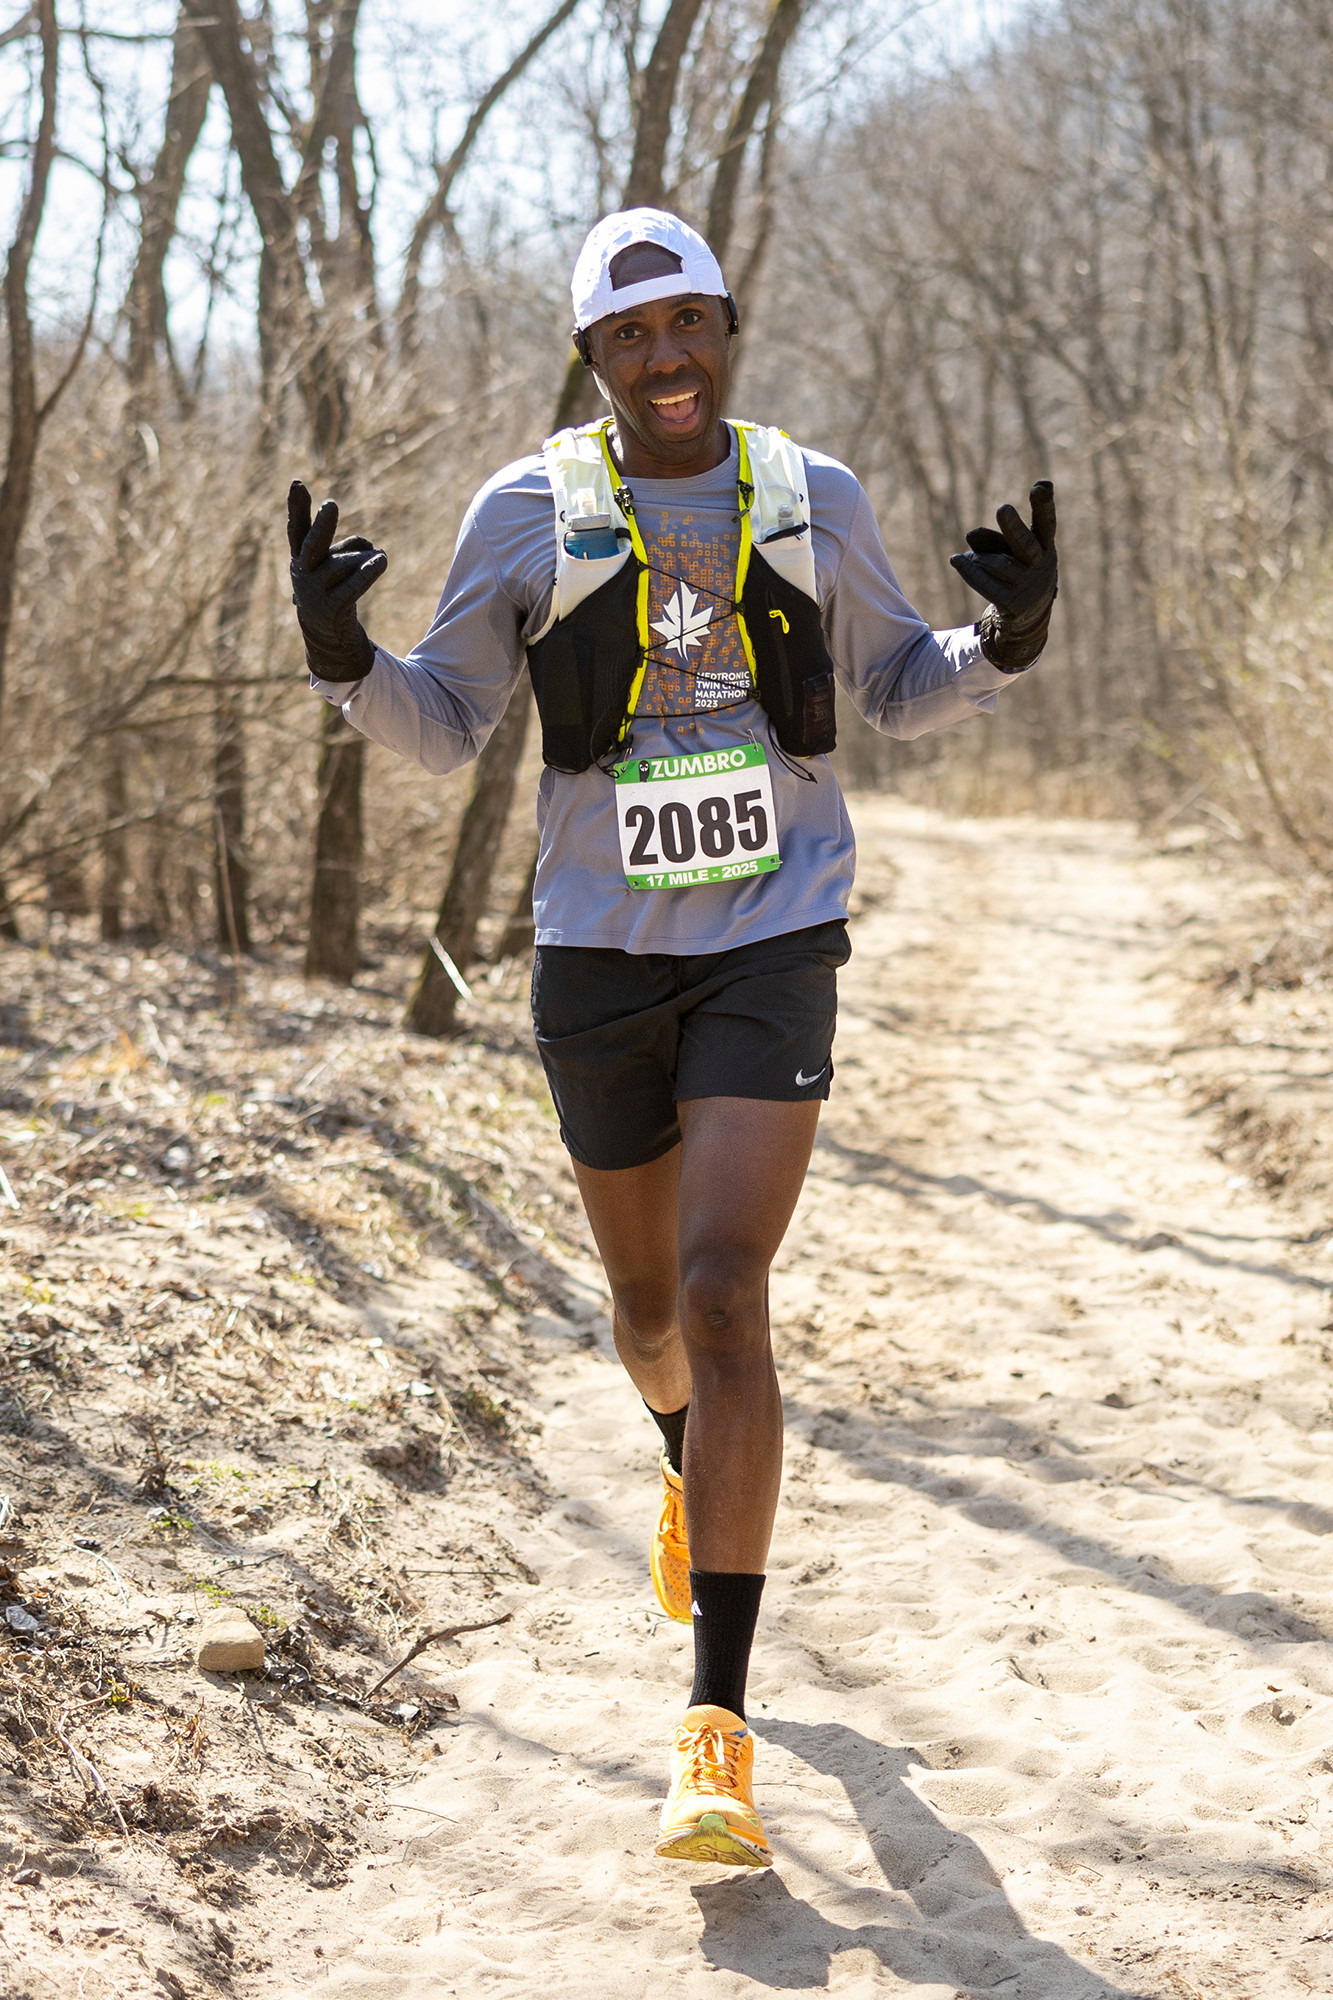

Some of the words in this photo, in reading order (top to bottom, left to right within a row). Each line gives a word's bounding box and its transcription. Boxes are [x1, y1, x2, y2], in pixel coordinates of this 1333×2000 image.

[696, 671, 750, 681] MEDTRONIC
[696, 680, 721, 690] TWIN
[695, 689, 748, 699] MARATHON
[694, 699, 719, 708] 2023
[652, 749, 747, 779] ZUMBRO
[625, 789, 768, 866] 2085
[646, 875, 665, 887] 17
[669, 869, 710, 886] MILE
[722, 861, 759, 879] 2025
